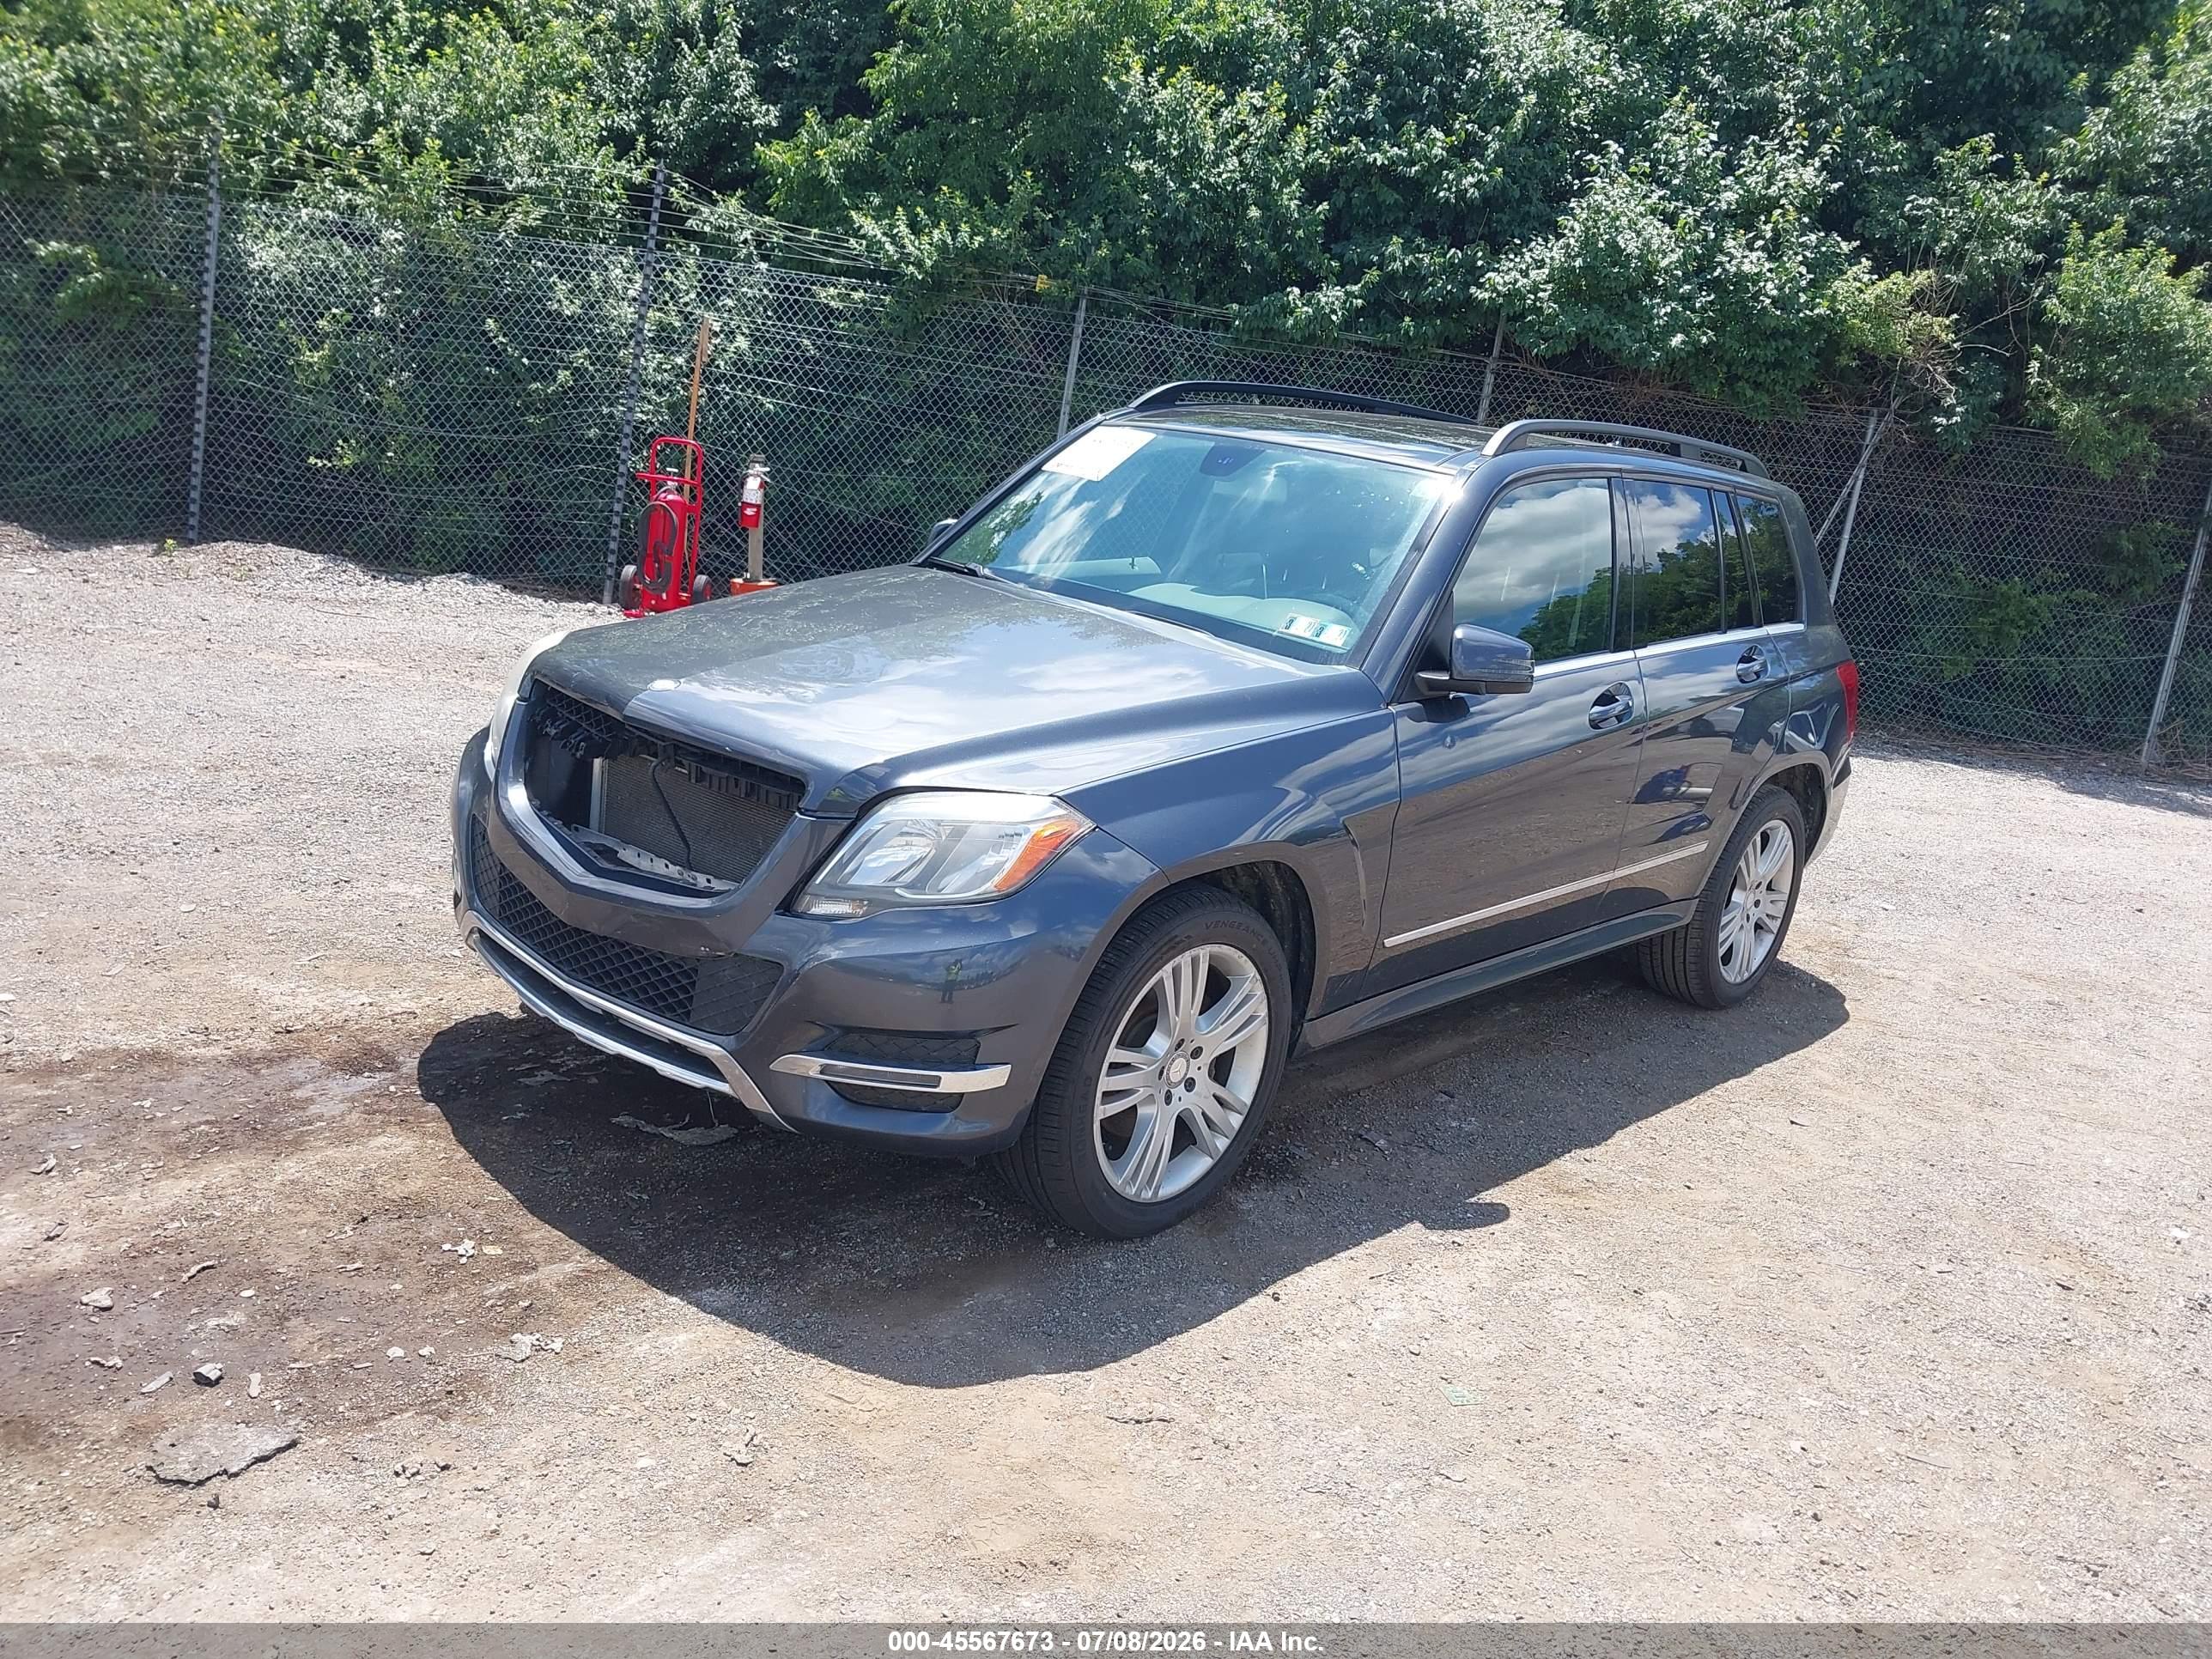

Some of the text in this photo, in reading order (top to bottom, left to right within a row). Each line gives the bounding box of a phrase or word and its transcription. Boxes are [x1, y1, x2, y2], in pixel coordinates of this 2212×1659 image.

[1285, 618, 1294, 630] 3
[1315, 625, 1325, 637] 3
[1204, 920, 1267, 945] VENGEANCE
